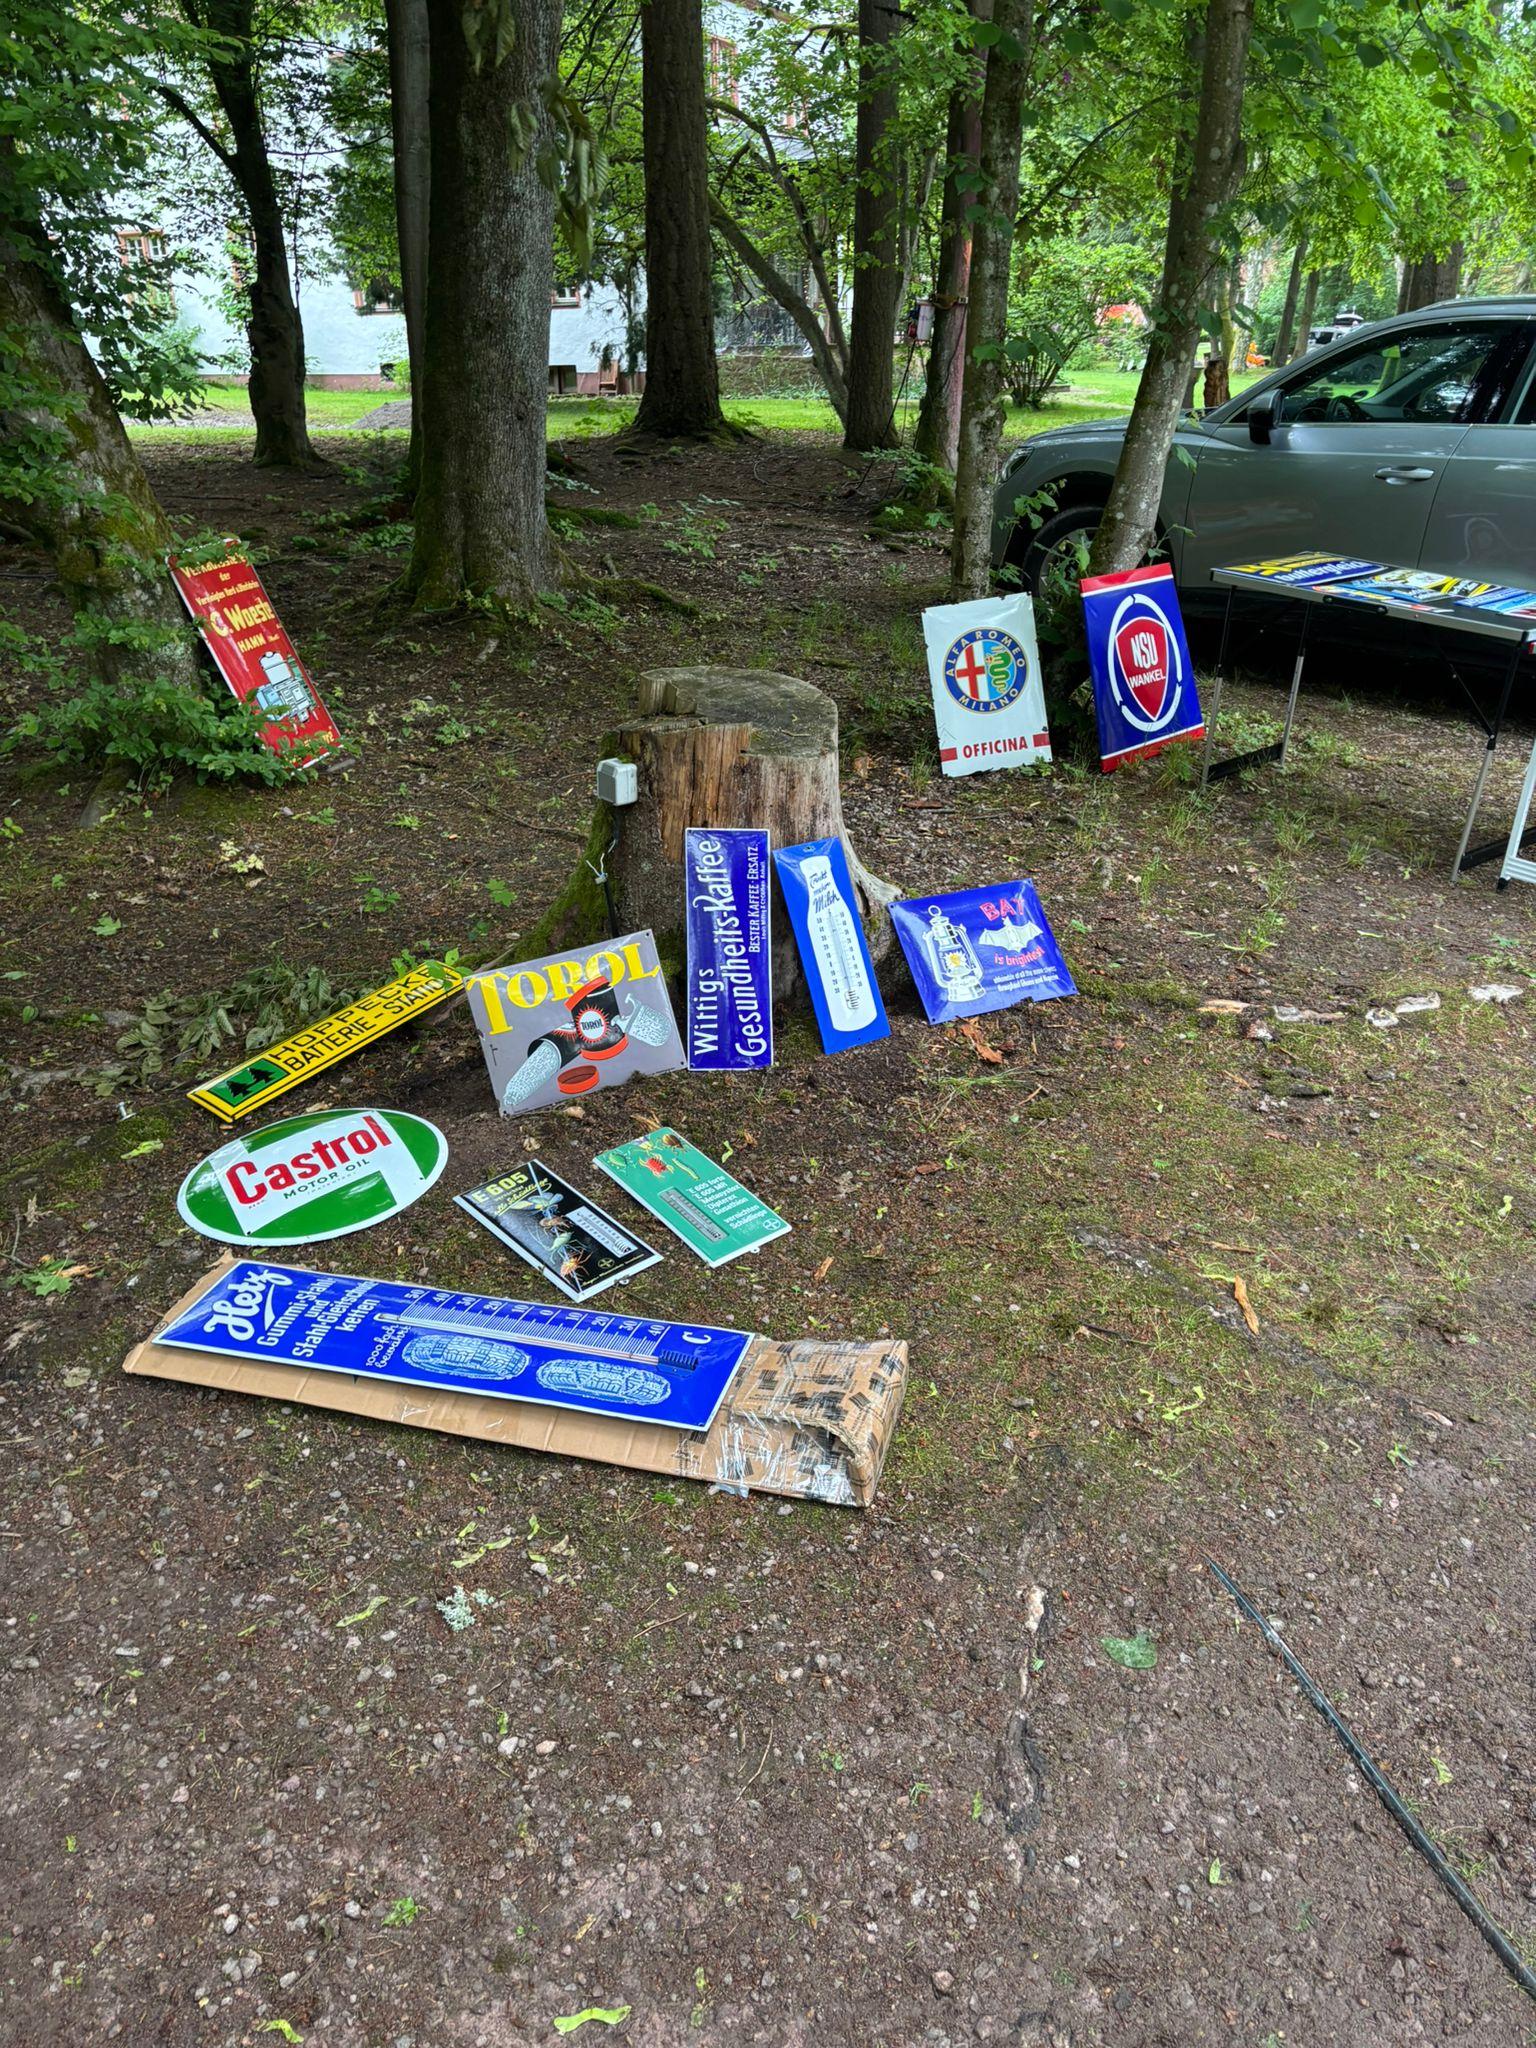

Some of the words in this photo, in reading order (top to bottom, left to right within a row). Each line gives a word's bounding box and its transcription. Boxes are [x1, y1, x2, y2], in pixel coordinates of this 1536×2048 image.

[945, 638, 970, 677] ALFA
[975, 630, 1026, 667] ROMEO
[1131, 631, 1159, 670] NSU
[1129, 669, 1166, 689] WANKEL
[959, 688, 1019, 711] MILANO
[963, 736, 1028, 759] OFFICINA
[812, 890, 840, 914] Milch
[979, 897, 1025, 921] BAT
[749, 920, 760, 953] BESTER
[693, 840, 768, 1057] Gesundheits-Kaffee
[994, 952, 1004, 965] is
[466, 942, 661, 1035] TOROL
[693, 968, 724, 1055] Wittigs
[581, 1018, 604, 1031] TOROL
[283, 1016, 377, 1073] BATTERIE
[226, 1115, 392, 1207] Castrol
[283, 1172, 339, 1200] MOTOR
[345, 1158, 370, 1172] OIL
[471, 1190, 489, 1203] E
[485, 1171, 529, 1196] 605
[404, 1289, 425, 1299] 50
[432, 1292, 450, 1303] 40
[456, 1297, 476, 1306] 30
[483, 1300, 503, 1310] 20
[304, 1300, 330, 1318] und
[334, 1299, 380, 1332] ketten
[511, 1304, 529, 1313] 10
[565, 1312, 583, 1321] 10
[591, 1316, 610, 1327] 20
[619, 1320, 637, 1331] 30
[647, 1324, 665, 1336] 40
[373, 1325, 399, 1344] fach
[365, 1344, 384, 1366] 1000
